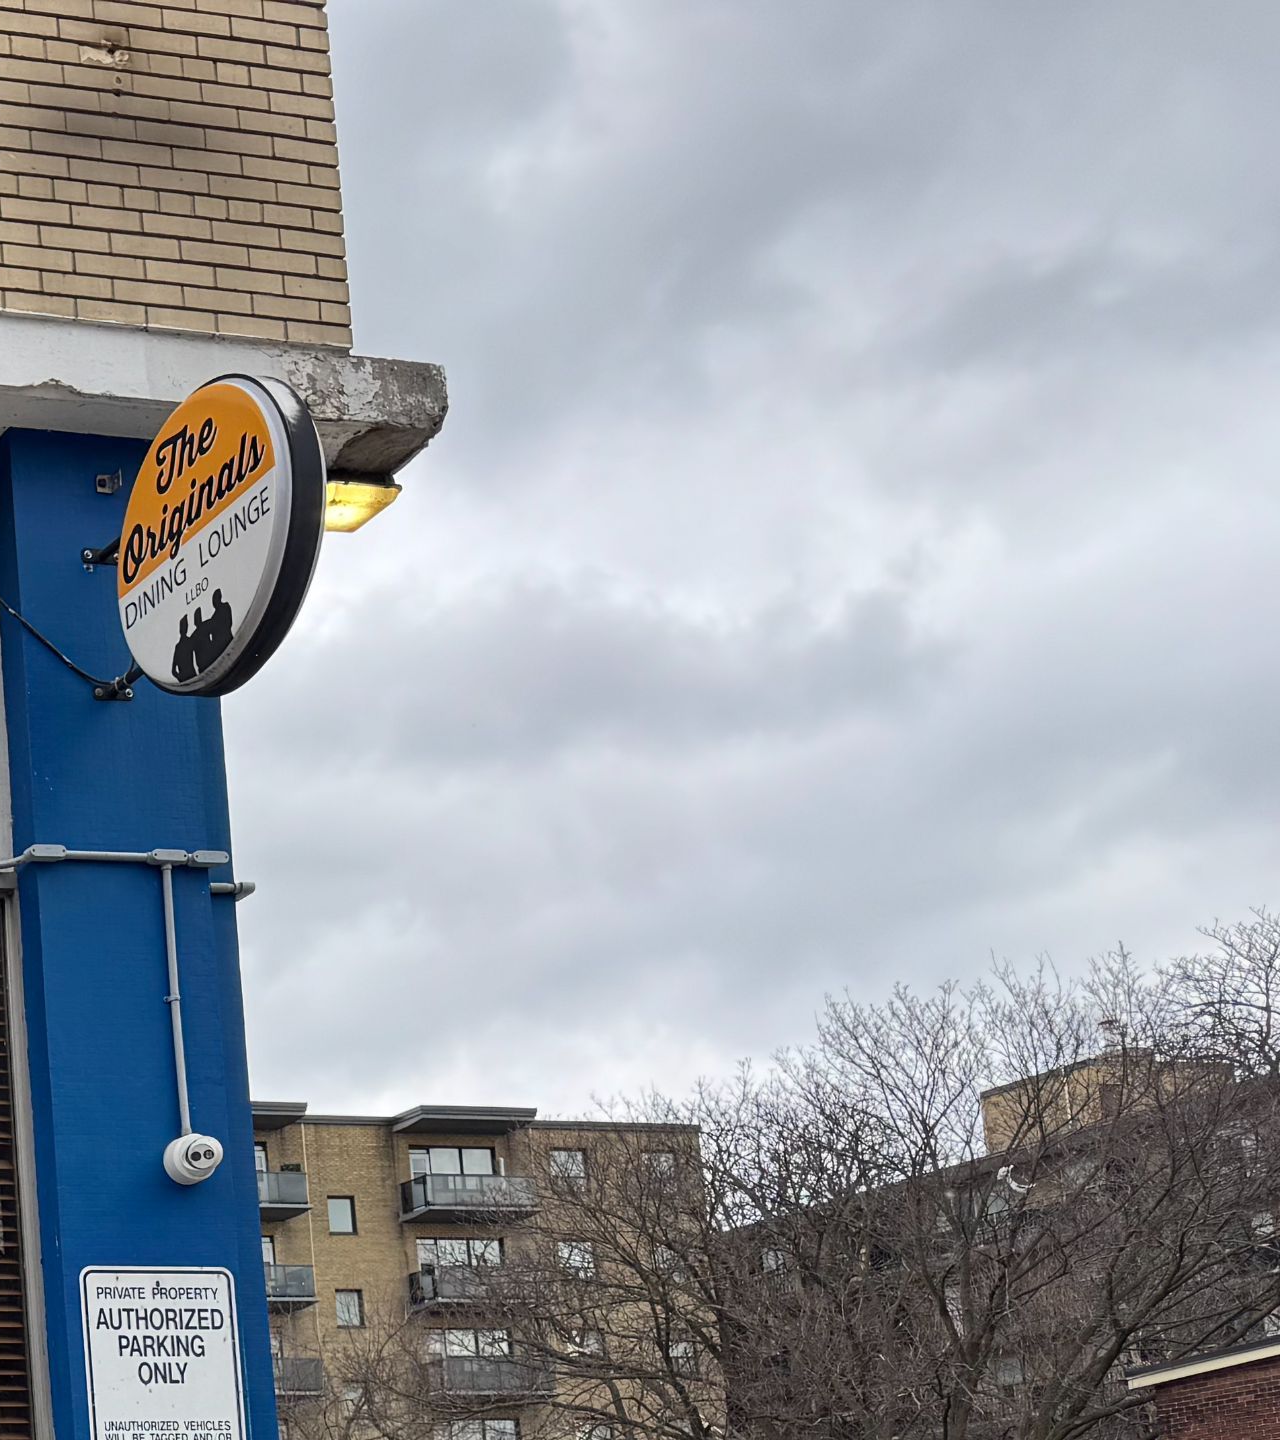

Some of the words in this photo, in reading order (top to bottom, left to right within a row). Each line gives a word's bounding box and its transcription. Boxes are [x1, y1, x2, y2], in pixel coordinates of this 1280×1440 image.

[155, 417, 217, 495] The
[122, 432, 265, 585] Originals
[124, 559, 187, 630] DINING
[199, 486, 271, 568] LOUNGE
[185, 577, 209, 606] LLBO
[96, 1287, 145, 1300] PRIVATE
[152, 1287, 218, 1300] PROPERTY
[96, 1308, 224, 1330] AUTHORIZED
[118, 1335, 205, 1357] PARKING
[138, 1362, 188, 1385] ONLY
[104, 1421, 179, 1431] UNAUTHORIZED
[184, 1421, 231, 1431] VEHICLES
